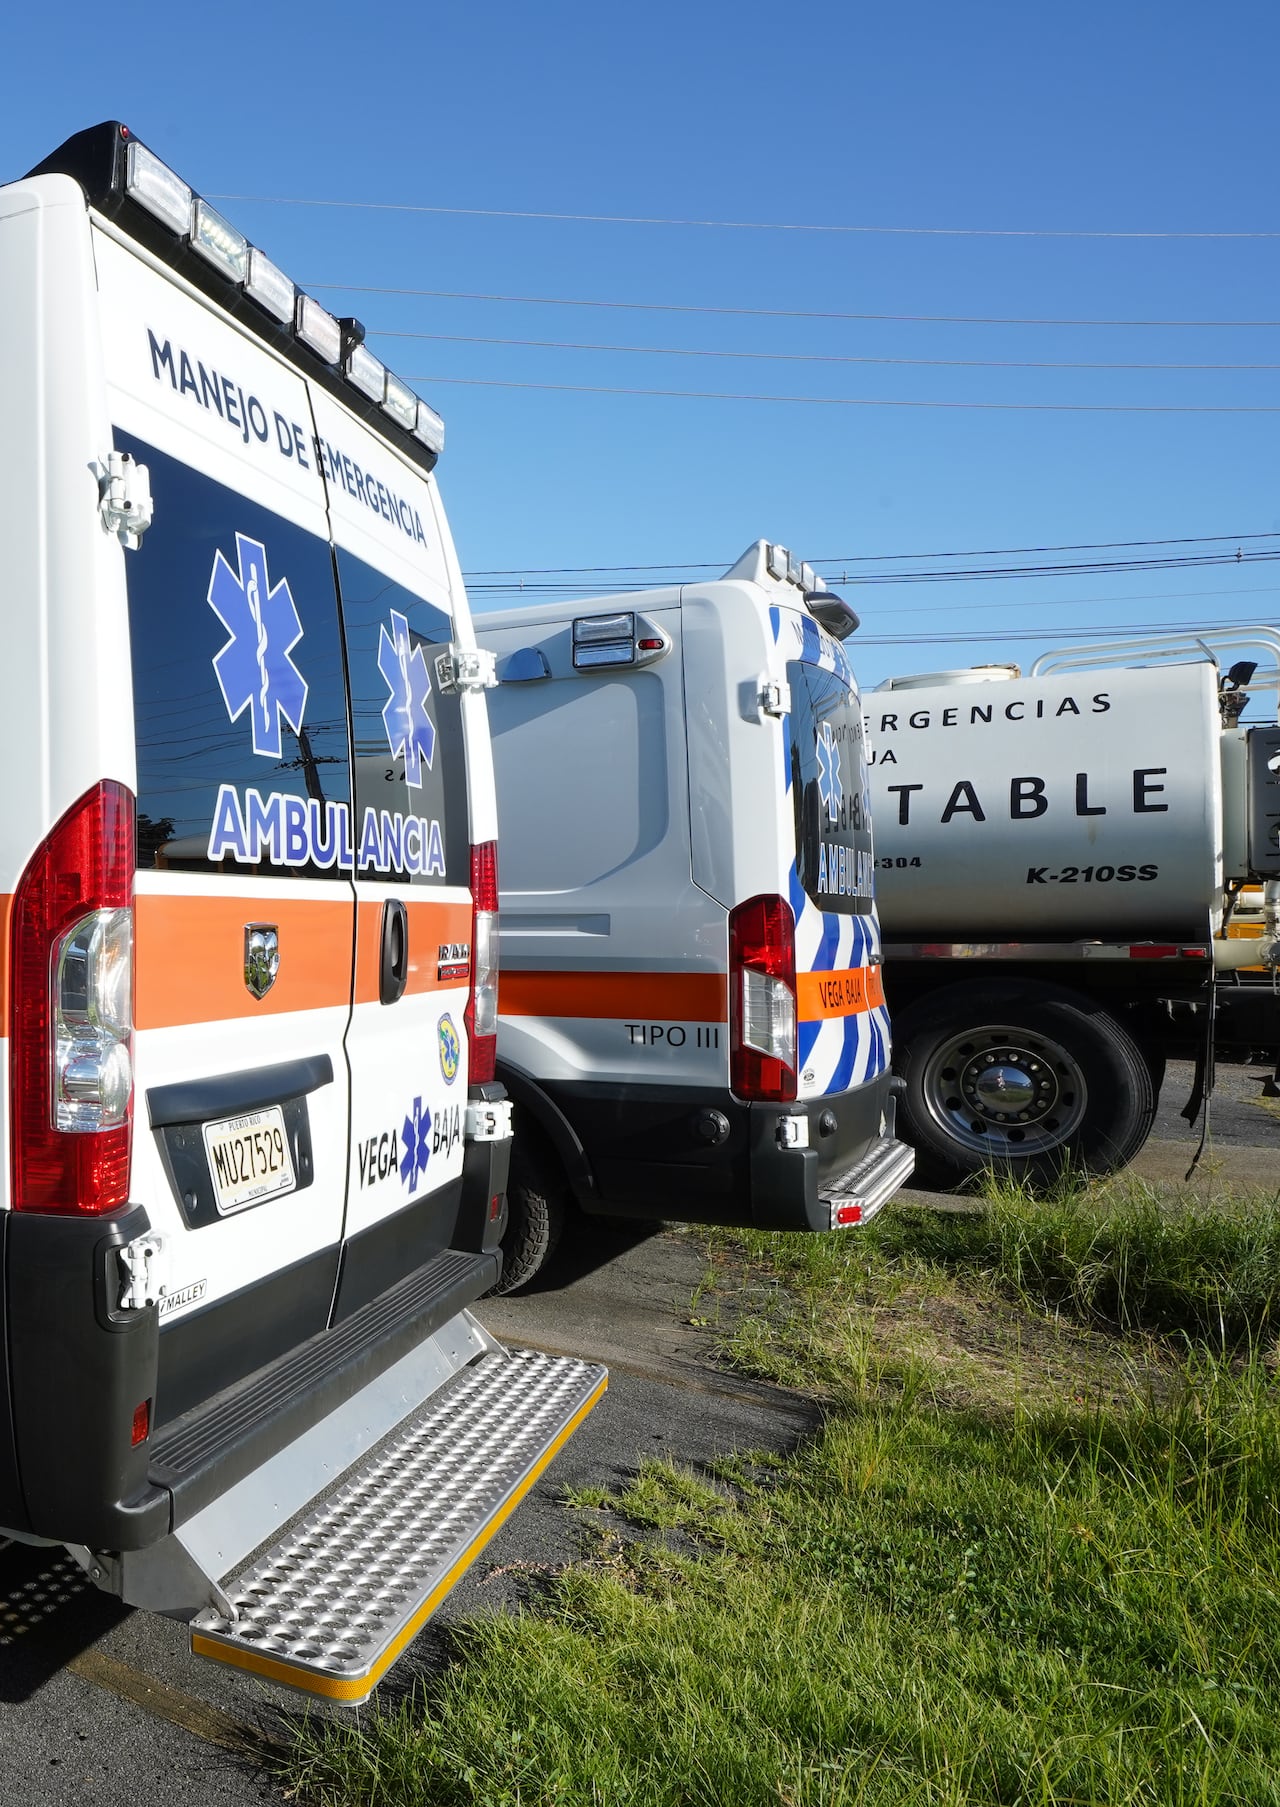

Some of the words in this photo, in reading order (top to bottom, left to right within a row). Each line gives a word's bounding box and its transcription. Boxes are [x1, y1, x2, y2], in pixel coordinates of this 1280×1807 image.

[147, 328, 268, 443] MANEJO
[273, 410, 309, 469] DE
[312, 435, 428, 548] EMERGENCIA
[888, 767, 1169, 826] TABLE
[209, 787, 445, 874] AMBULANCIA
[1026, 864, 1159, 884] K-210SS
[819, 981, 845, 1008] VEGA
[625, 1024, 686, 1047] TIPO
[697, 1027, 719, 1049] III
[213, 1127, 284, 1189] MU27529
[358, 1129, 398, 1190] VEGA
[432, 1104, 460, 1160] BAJA
